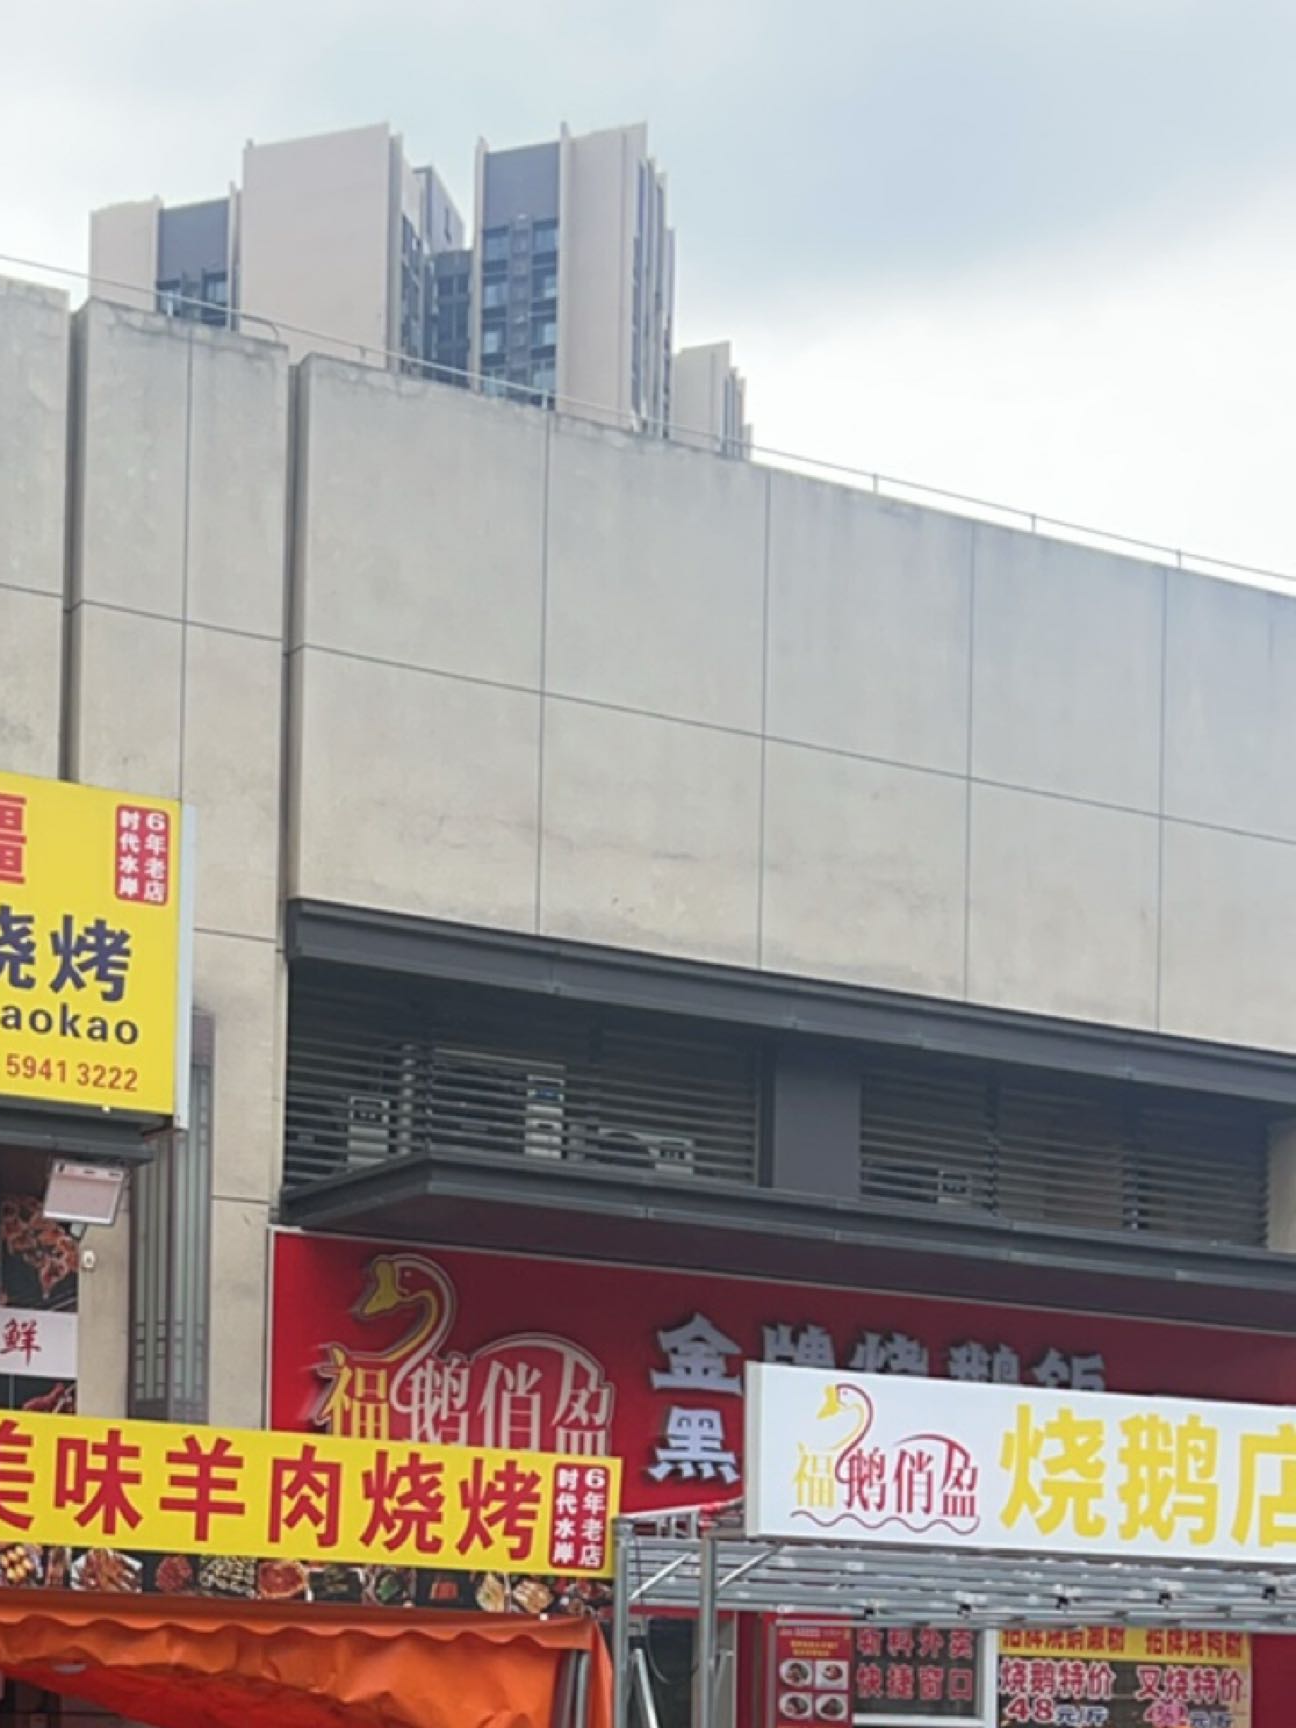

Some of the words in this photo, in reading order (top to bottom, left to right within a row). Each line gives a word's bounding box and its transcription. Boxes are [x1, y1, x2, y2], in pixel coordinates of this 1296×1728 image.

[118, 809, 141, 899] 时代水岸
[145, 812, 168, 904] 6年老店
[555, 1467, 578, 1567] 时代水岸
[582, 1467, 607, 1570] 6年老店
[999, 1403, 1296, 1548] 烧鹅店
